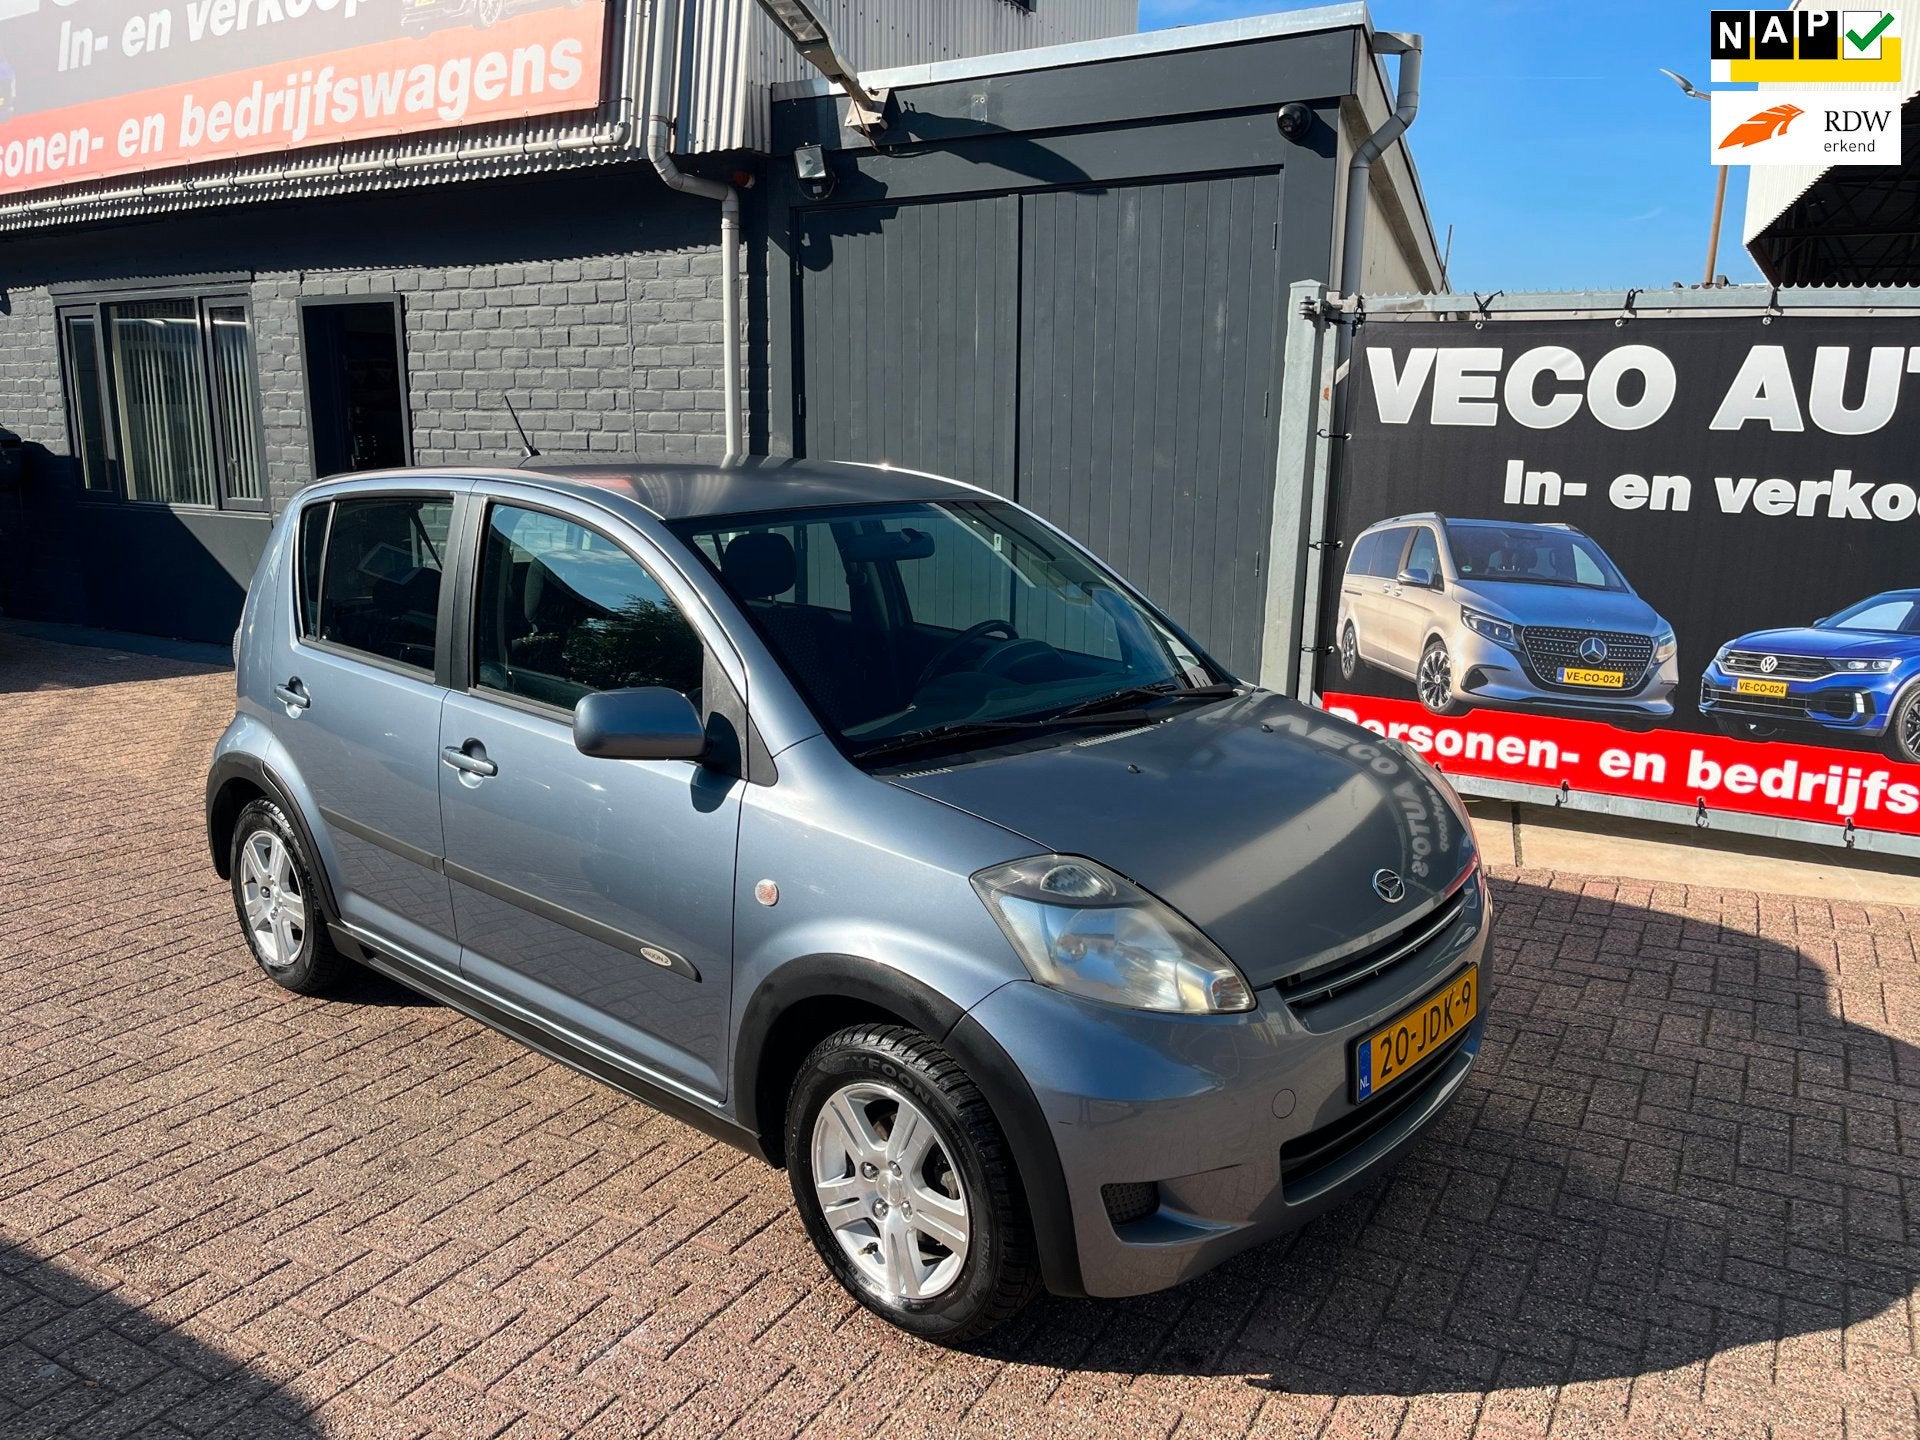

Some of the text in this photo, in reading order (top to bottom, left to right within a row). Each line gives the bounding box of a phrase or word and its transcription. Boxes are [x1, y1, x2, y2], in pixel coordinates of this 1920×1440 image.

[58, 20, 108, 72] In-
[122, 9, 171, 57] en
[0, 39, 582, 178] onen- en bedrijfswagens
[1366, 345, 1920, 435] VECO AU
[1503, 459, 1920, 521] In- en verko
[1565, 671, 1621, 685] VE-CO-024
[1738, 681, 1785, 695] VE-CO-024
[1599, 749, 1666, 783] en
[1686, 749, 1919, 816] bedrijfs
[1380, 980, 1471, 1079] 20-JDK-9
[1359, 1075, 1370, 1091] NL
